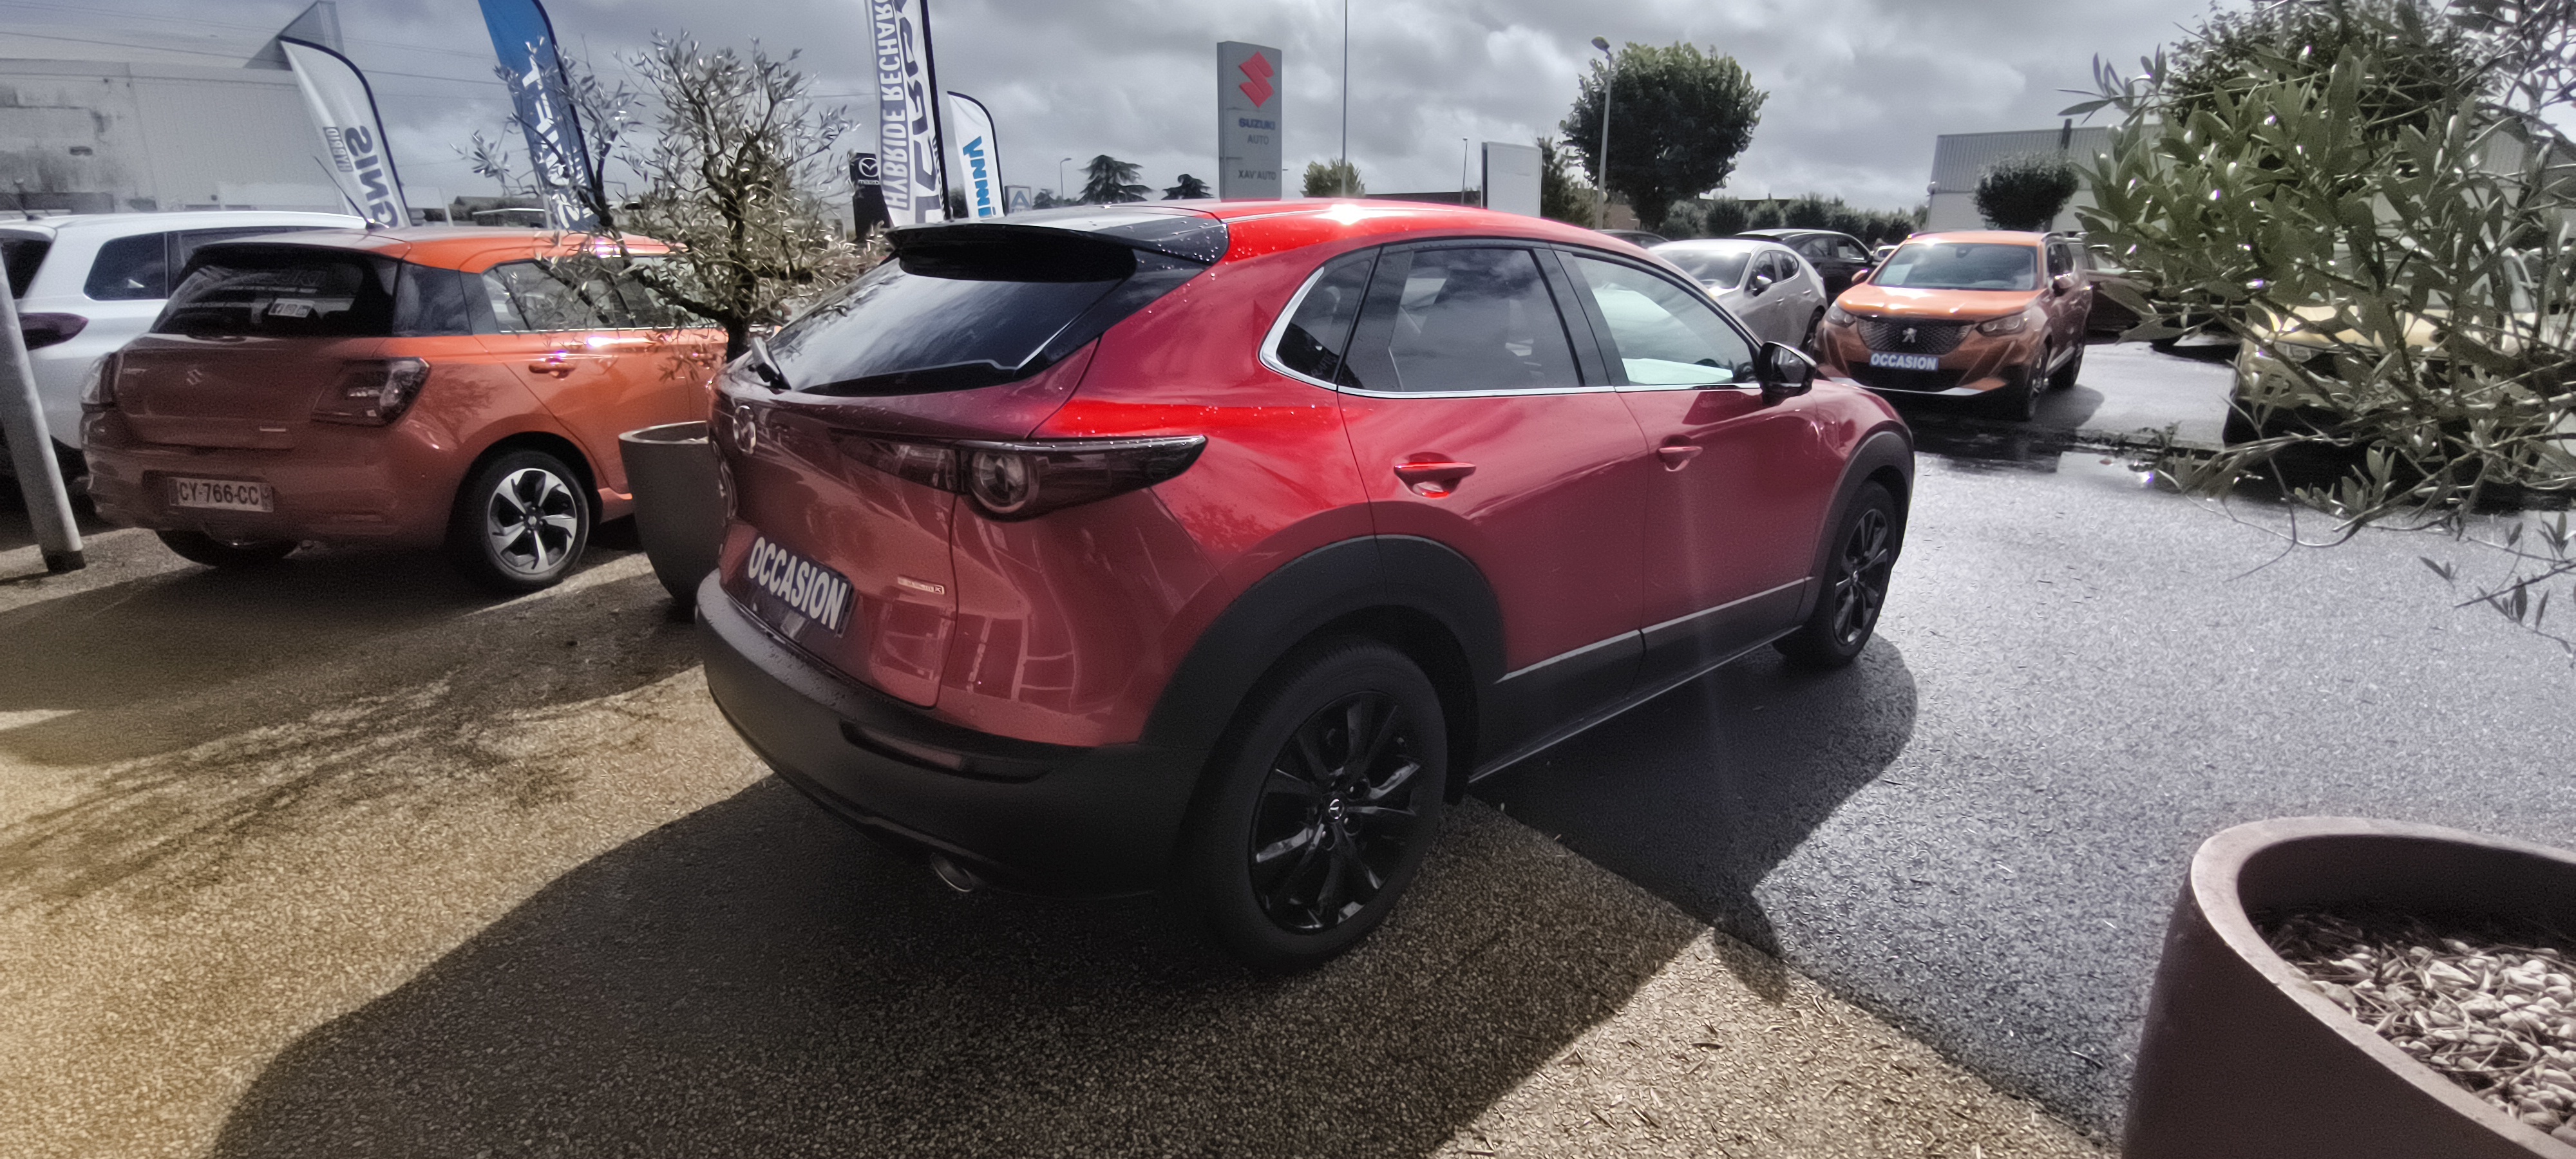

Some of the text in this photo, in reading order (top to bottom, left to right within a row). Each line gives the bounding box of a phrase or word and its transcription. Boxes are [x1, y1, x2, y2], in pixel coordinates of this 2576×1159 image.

[1239, 118, 1276, 130] SUZUKI
[1247, 135, 1269, 145] AUTO
[1871, 353, 1937, 370] OCCASION
[179, 482, 259, 505] CY-766-CC
[748, 536, 847, 630] OCCASION
